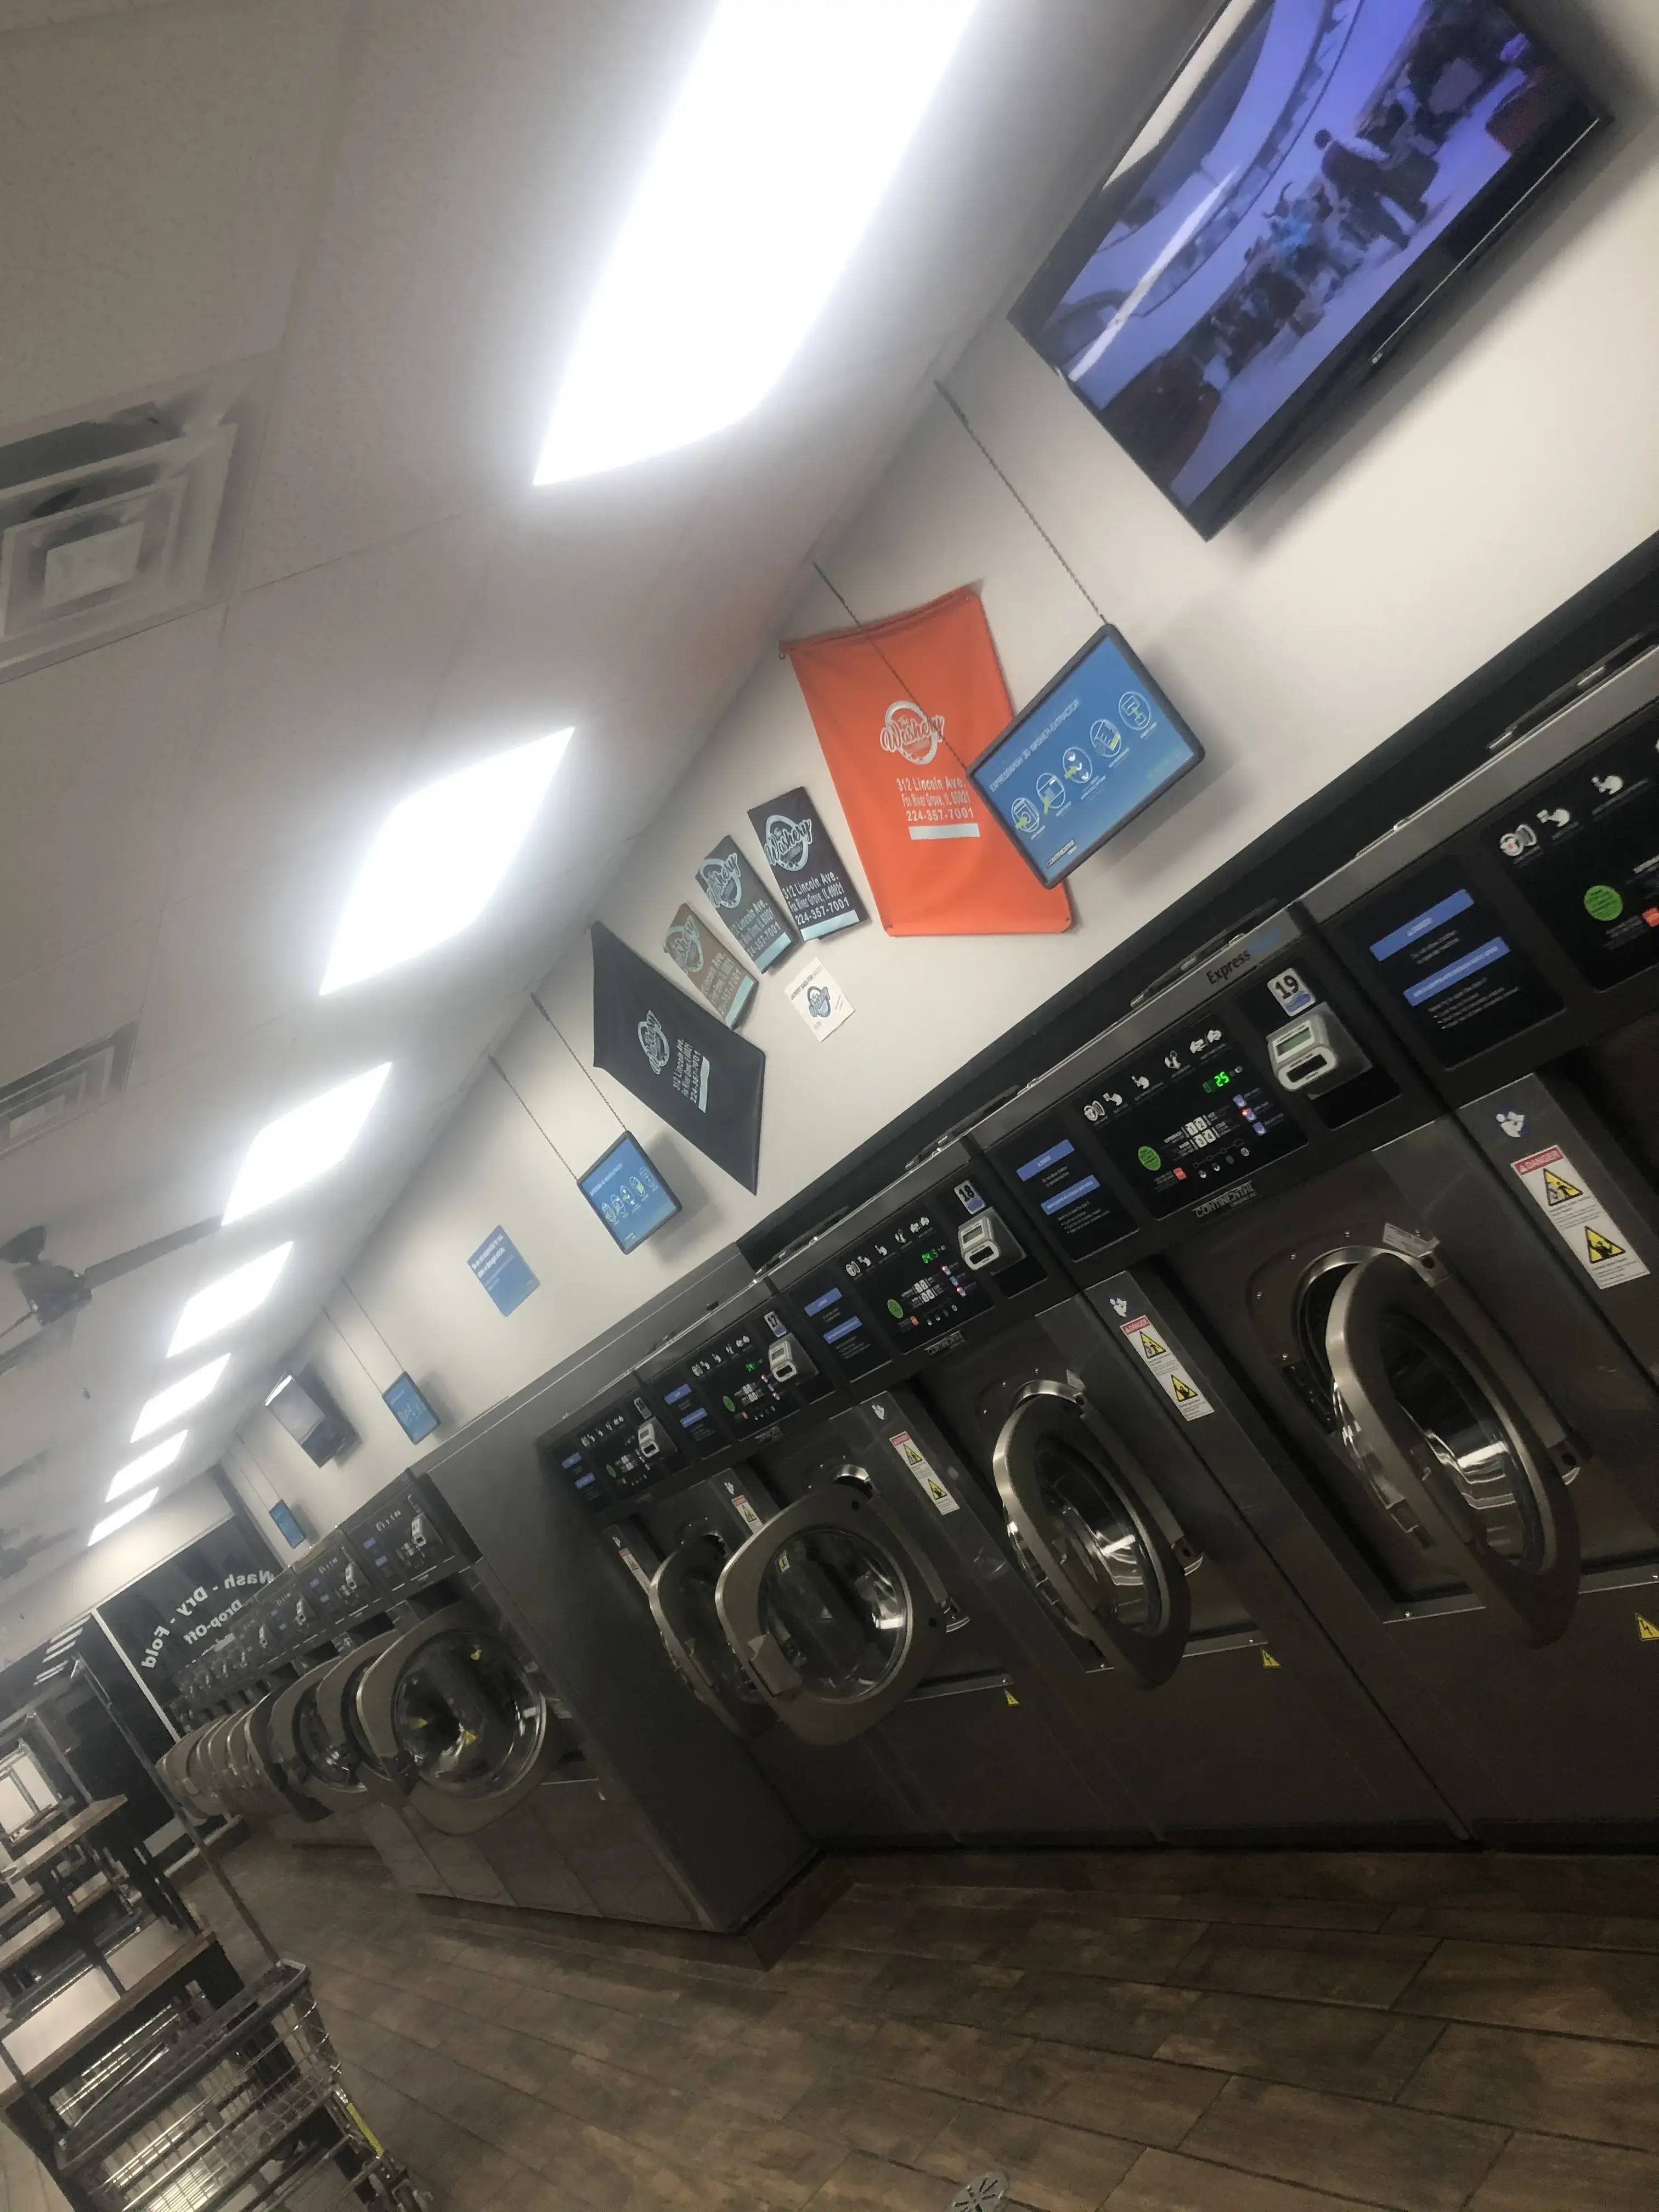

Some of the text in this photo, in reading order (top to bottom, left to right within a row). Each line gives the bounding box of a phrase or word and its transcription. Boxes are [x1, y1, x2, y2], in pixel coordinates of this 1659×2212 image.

[896, 775, 966, 792] 312 Lincoln Ave.
[906, 807, 974, 821] 224-357-7001
[764, 819, 812, 866] Washery
[782, 871, 838, 900] 312 Lincoln Ave.
[795, 896, 808, 911] River
[807, 891, 825, 905] Grove,
[828, 882, 845, 898] 60021
[795, 897, 850, 926] 224-357-7001
[746, 921, 781, 957] 24-357-7001
[1206, 950, 1250, 985] Express
[1274, 975, 1299, 1000] 19
[1214, 1071, 1229, 1087] 25
[1526, 1149, 1561, 1169] DANGER
[958, 1184, 975, 1203] 18
[768, 1314, 777, 1328] 17
[1130, 1319, 1149, 1331] DANGER
